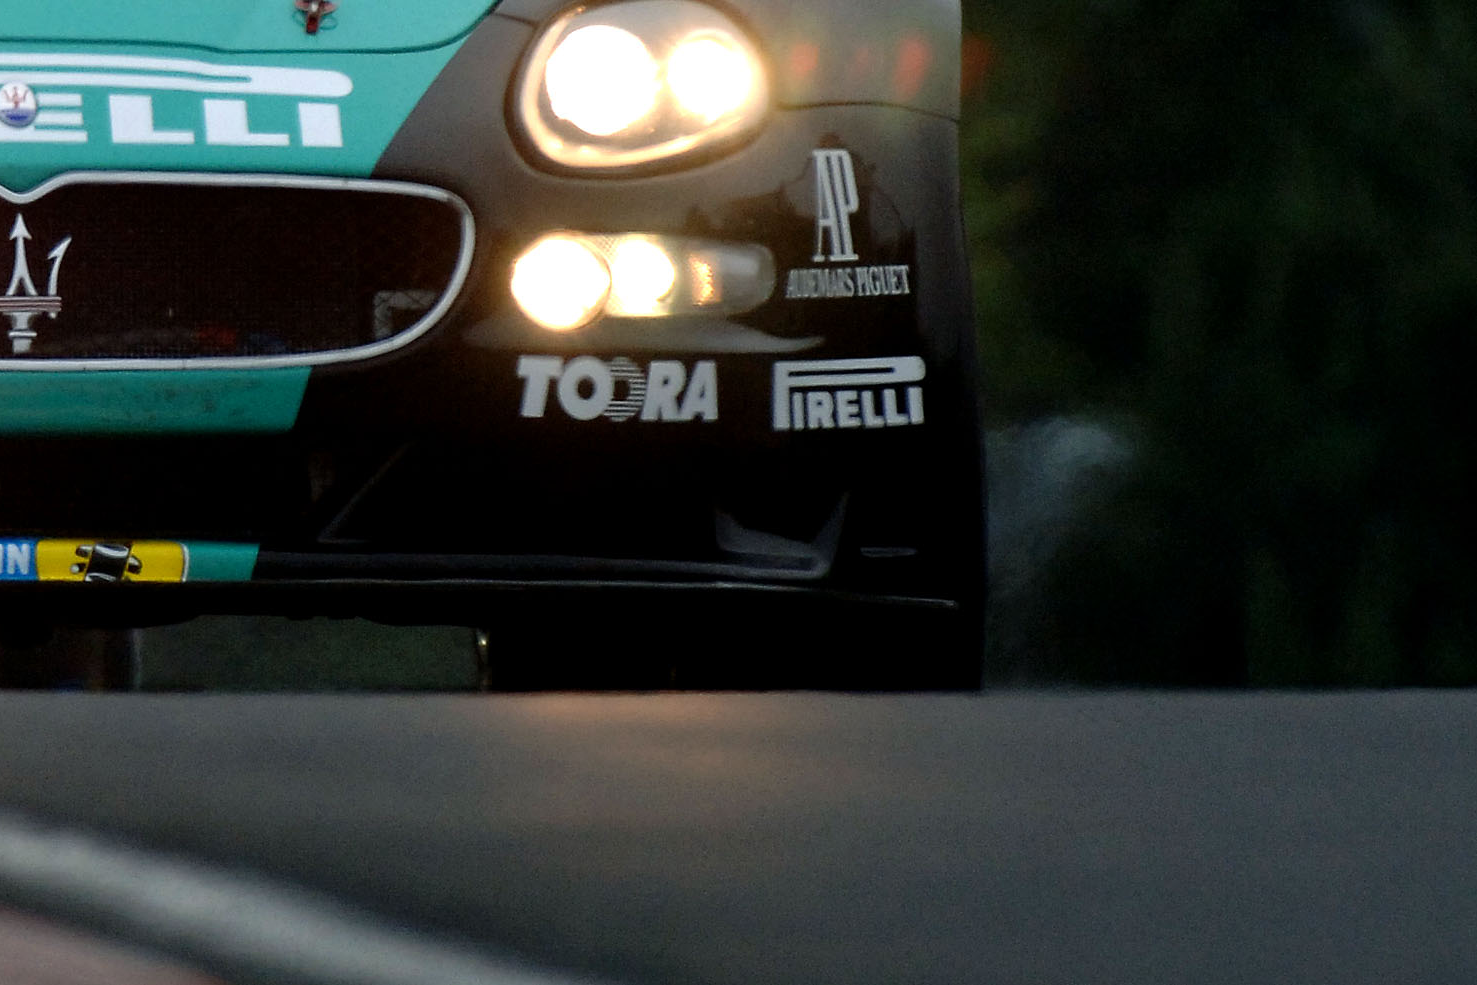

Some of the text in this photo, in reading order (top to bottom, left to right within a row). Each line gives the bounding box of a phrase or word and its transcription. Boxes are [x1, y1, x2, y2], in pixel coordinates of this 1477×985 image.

[813, 149, 859, 262] AP
[856, 265, 910, 296] PIGUET
[517, 356, 718, 423] TOORA
[772, 356, 926, 430] PIRELLI
